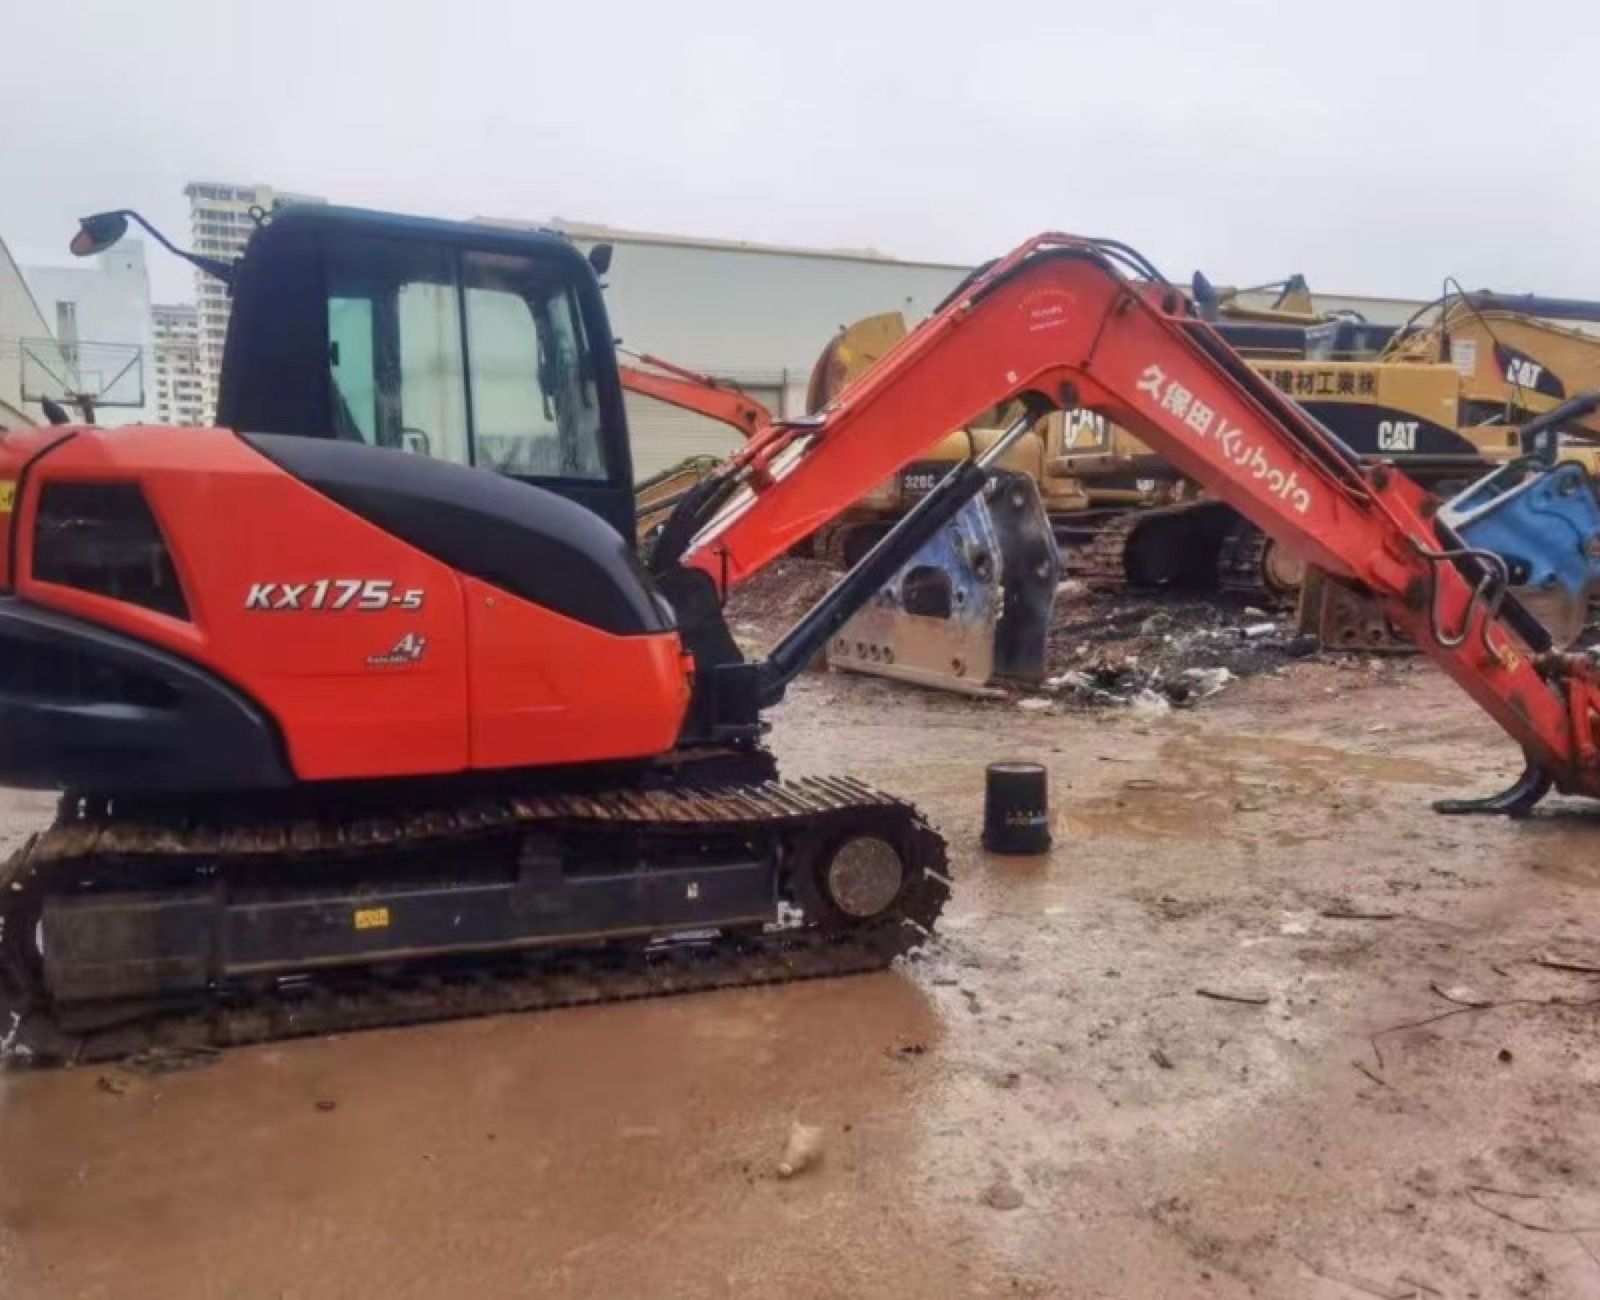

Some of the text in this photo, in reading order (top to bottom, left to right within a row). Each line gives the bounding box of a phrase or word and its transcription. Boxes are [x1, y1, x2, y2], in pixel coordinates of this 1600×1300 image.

[1136, 364, 1311, 514] 久保田 Kubota
[1377, 421, 1419, 450] CAT
[245, 579, 424, 609] KX175-5
